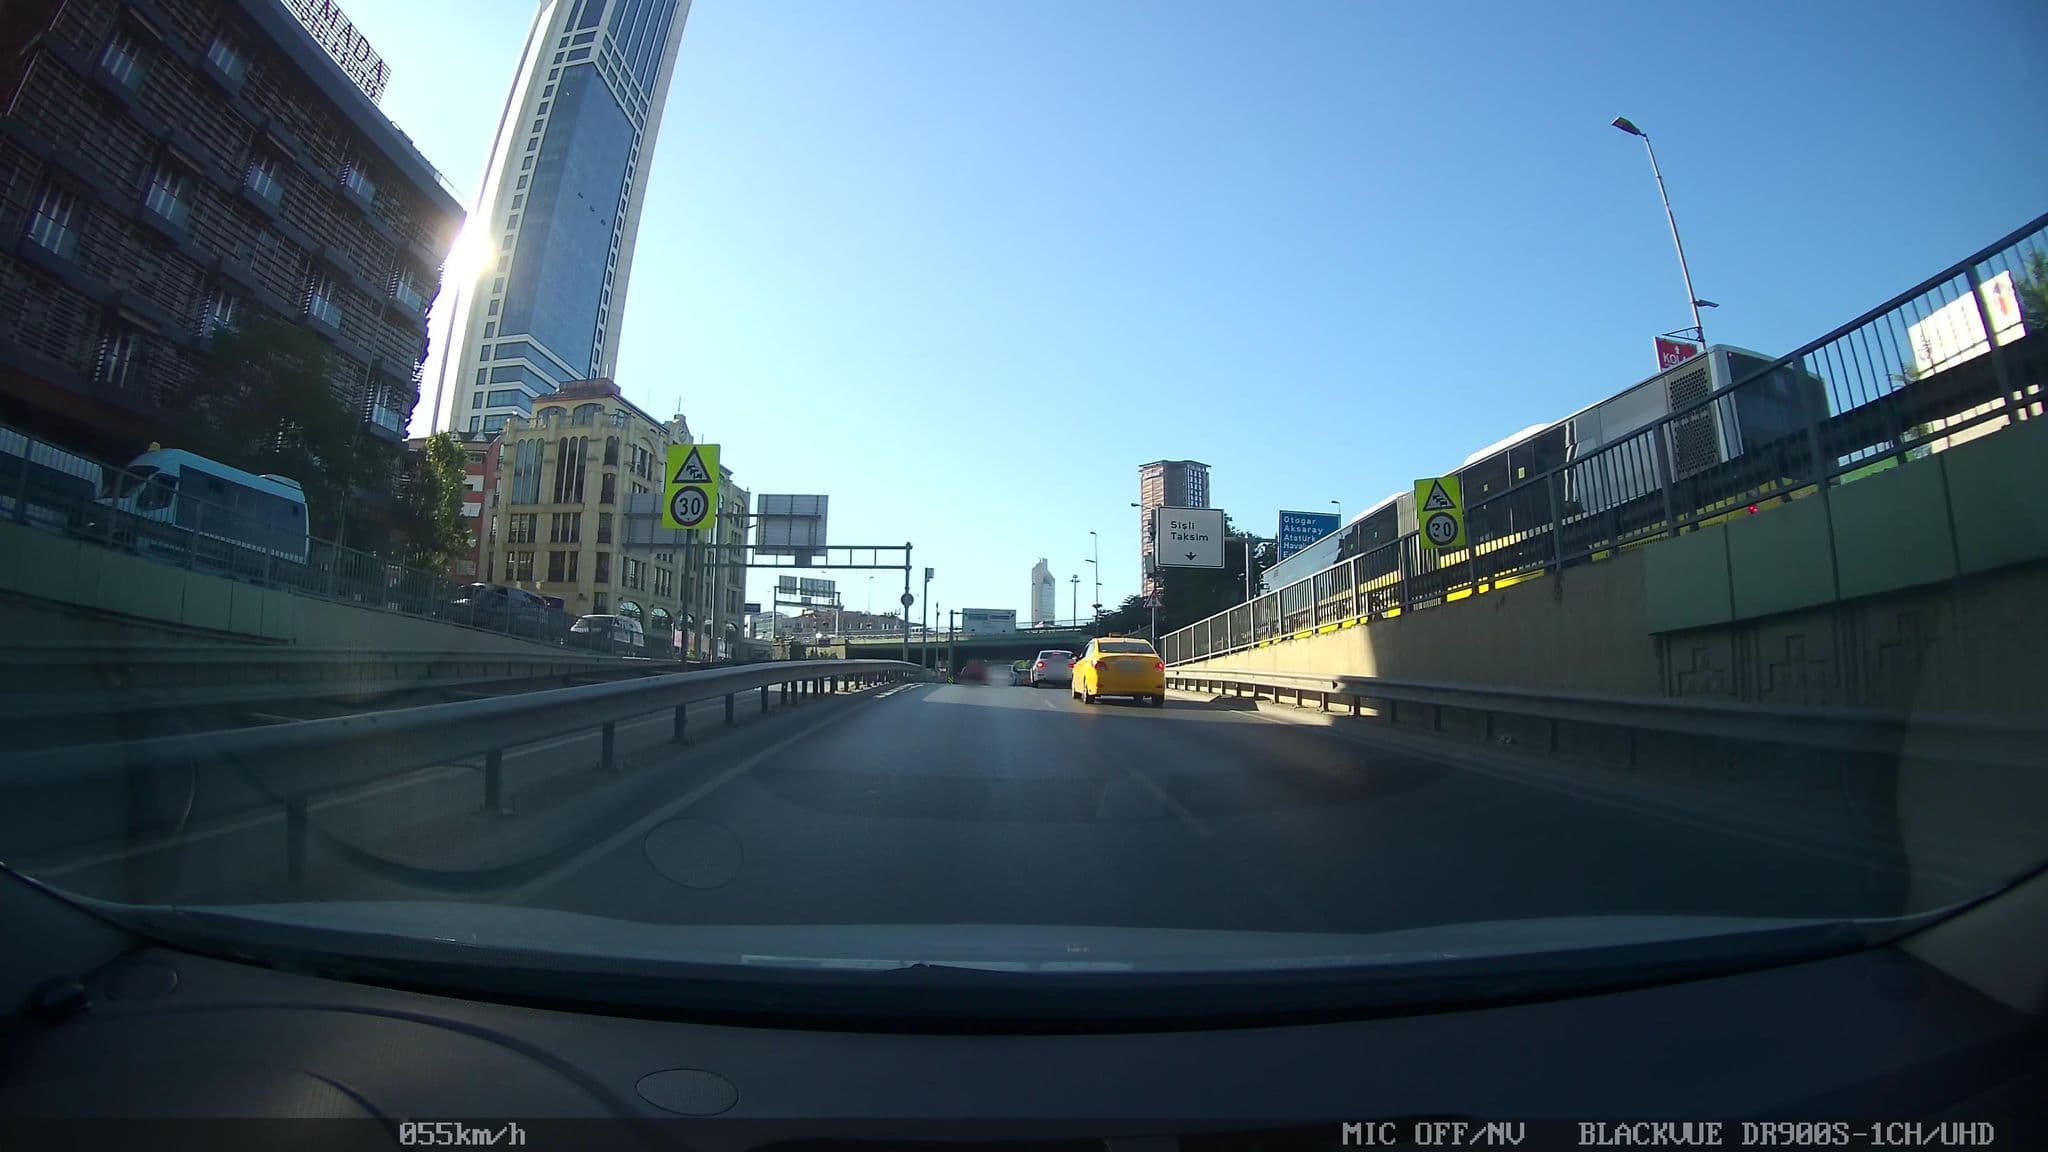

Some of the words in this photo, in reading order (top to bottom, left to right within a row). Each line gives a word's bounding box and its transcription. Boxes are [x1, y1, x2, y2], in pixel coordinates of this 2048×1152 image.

[340, 51, 377, 98] SUITES
[679, 497, 701, 516] 30
[1283, 515, 1317, 526] Otogar
[1283, 525, 1324, 536] Aksaray
[1431, 521, 1452, 538] 30
[1170, 532, 1209, 542] Taksim
